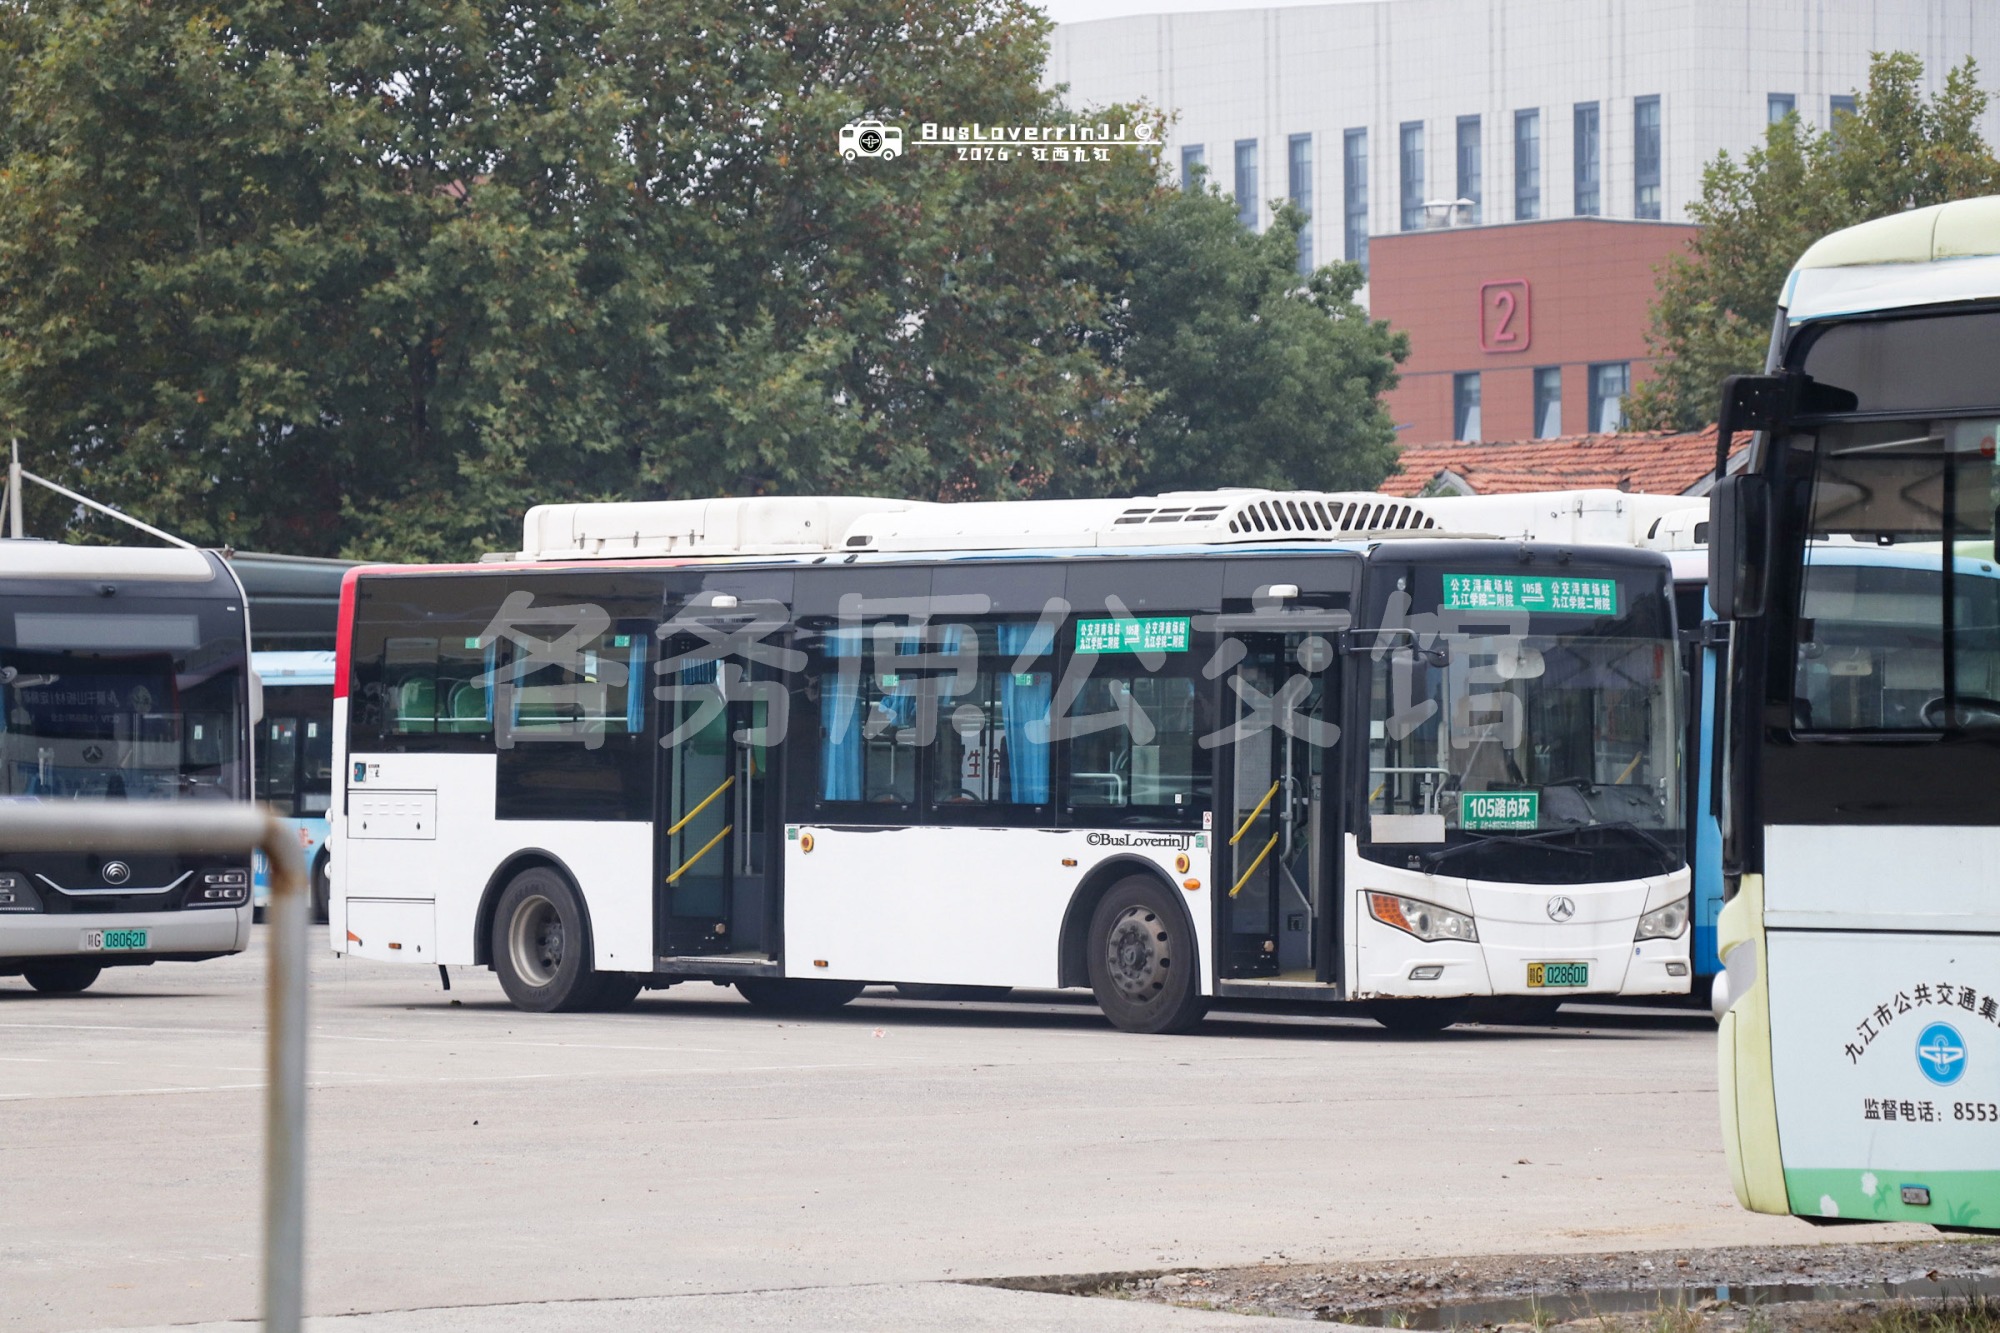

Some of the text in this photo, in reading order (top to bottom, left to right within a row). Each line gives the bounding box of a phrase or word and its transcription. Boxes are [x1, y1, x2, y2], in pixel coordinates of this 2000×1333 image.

[1494, 291, 1516, 342] 2
[1521, 583, 1543, 595] 105路
[1470, 797, 1530, 818] 105路内环
[1845, 982, 2000, 1064] 九江市公共交通集
